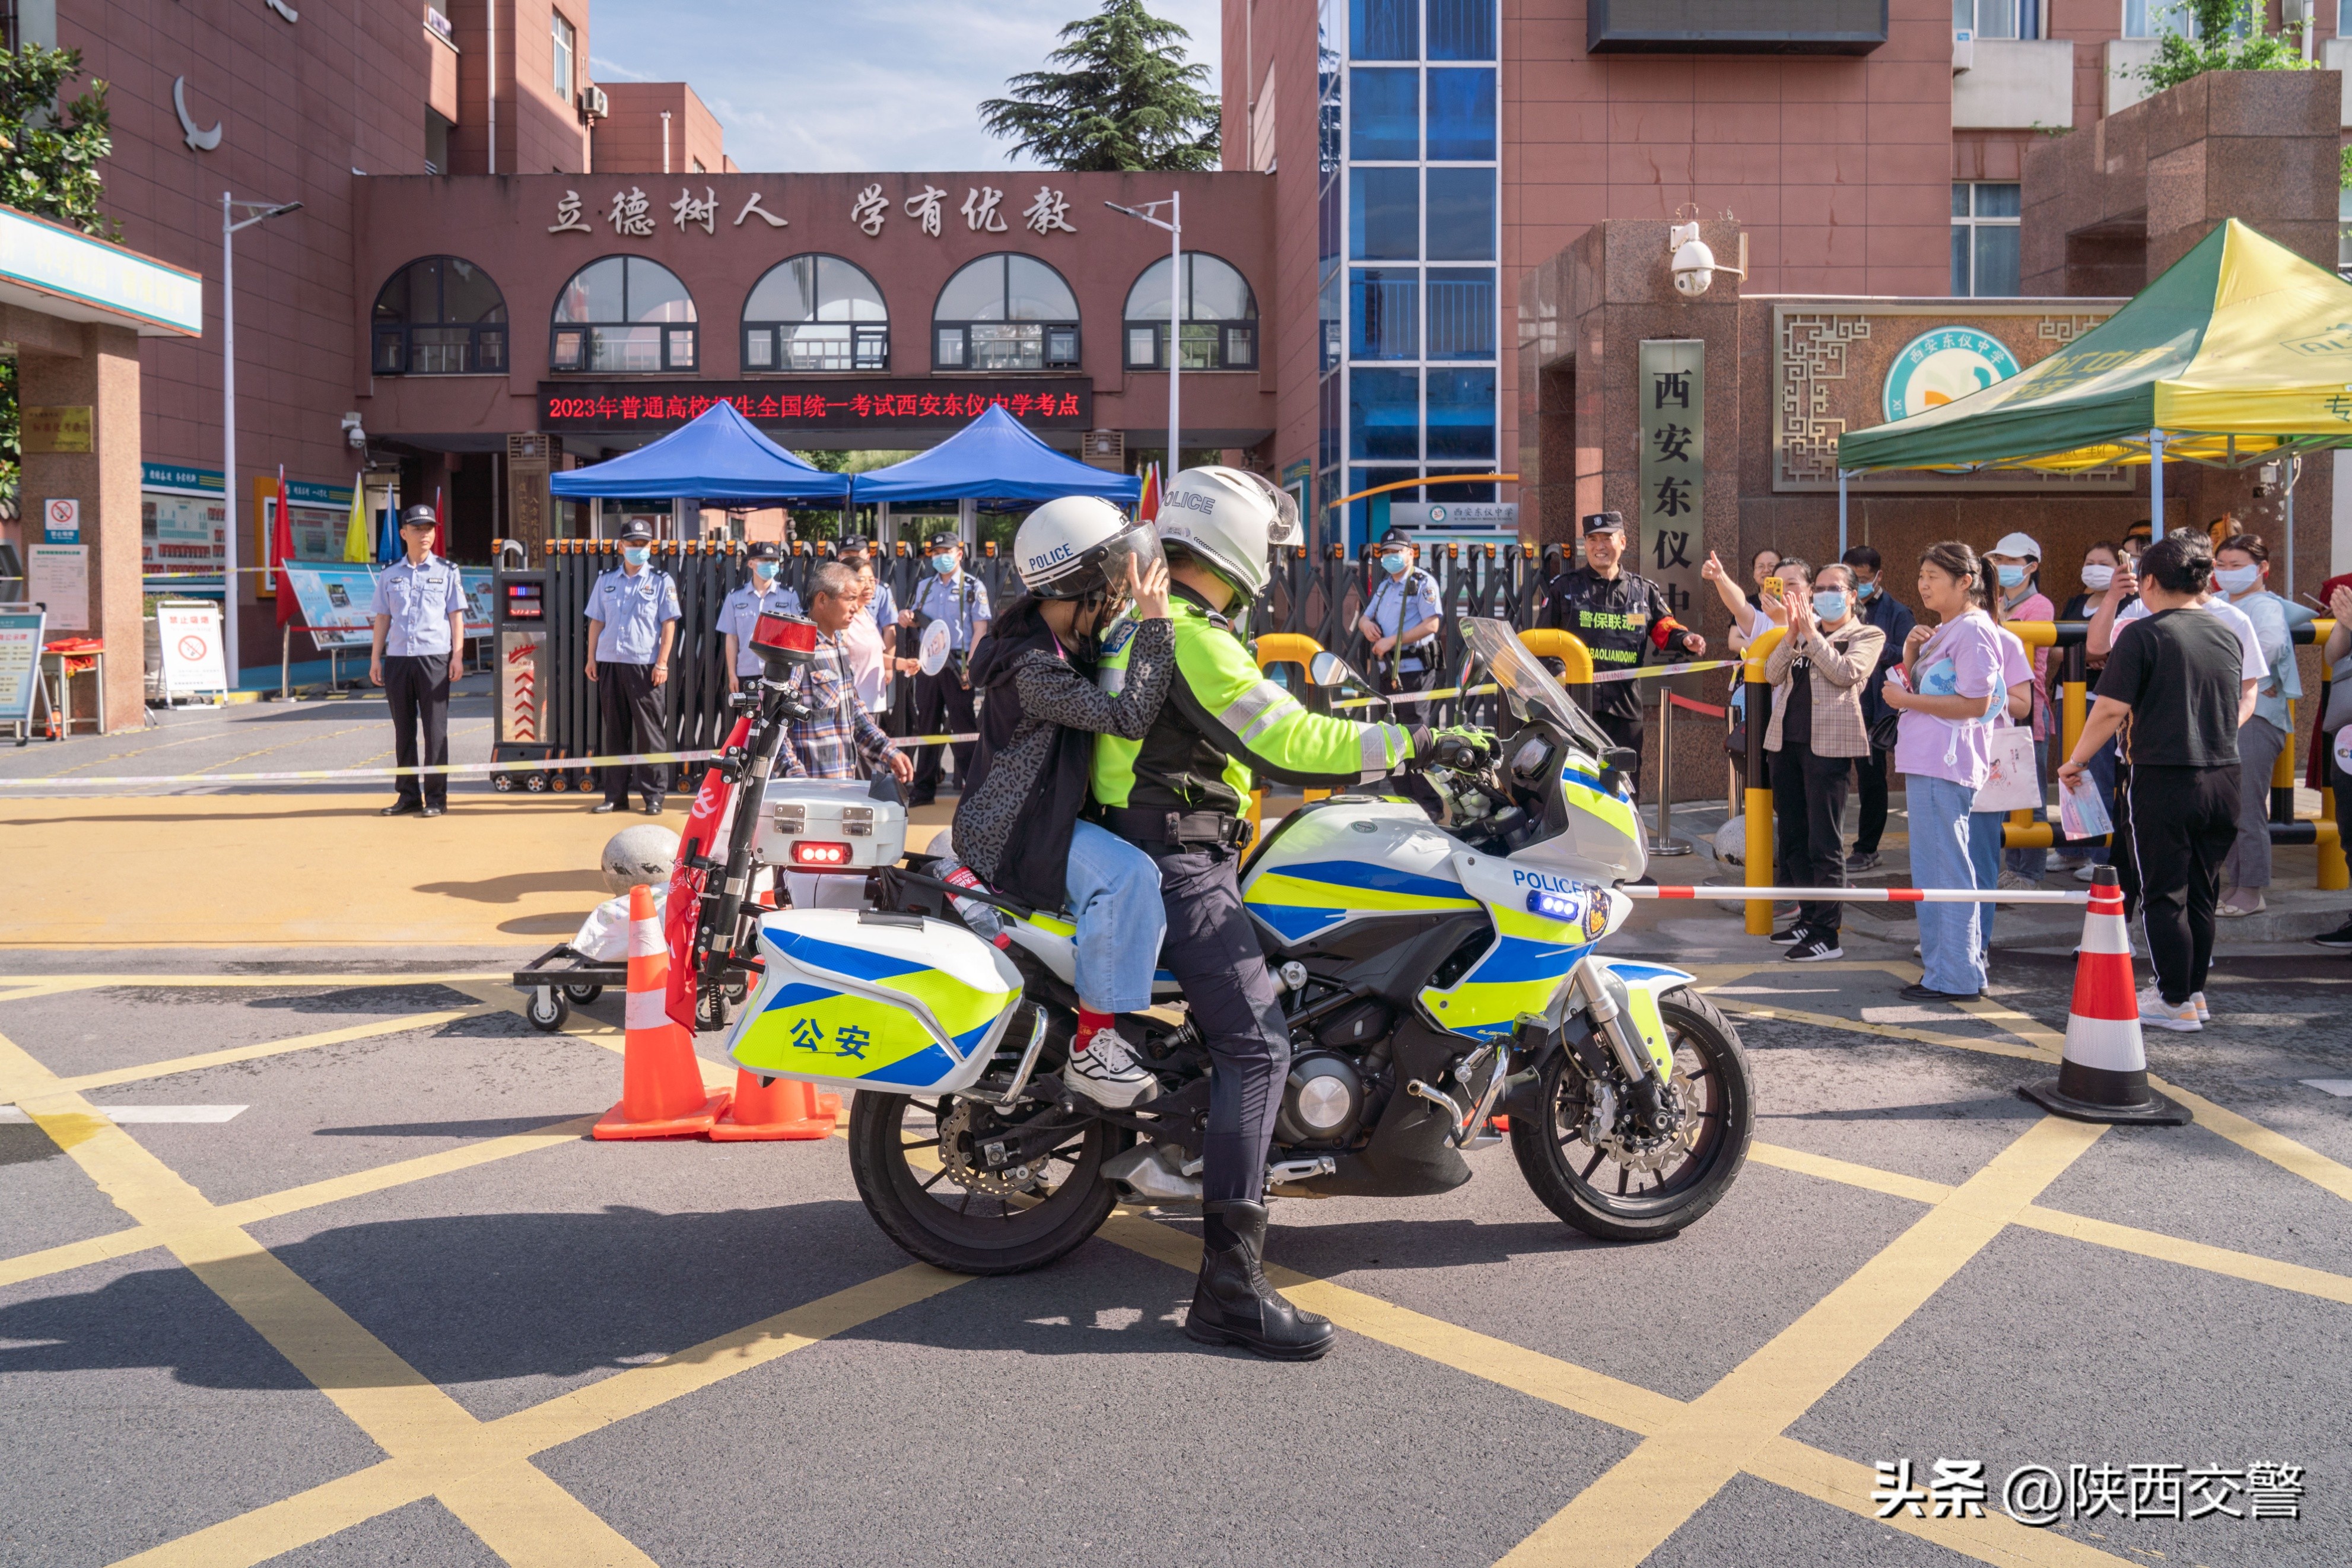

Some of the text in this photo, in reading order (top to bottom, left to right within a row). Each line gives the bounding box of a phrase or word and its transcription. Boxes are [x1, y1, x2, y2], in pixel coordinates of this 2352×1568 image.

[547, 183, 1077, 237] 立德树人 学有优教
[1910, 333, 2004, 364] 西安东仪中学
[1160, 491, 1216, 514] OLICE
[1454, 507, 1513, 517] 西安东仪中学
[1652, 369, 1693, 675] 西安东仪中
[1029, 543, 1073, 571] POLICE
[1588, 647, 1638, 664] BAOLIANDONG
[1593, 671, 1626, 682] MITLINE
[1513, 869, 1585, 898] POLICE
[790, 1017, 870, 1060] 公安
